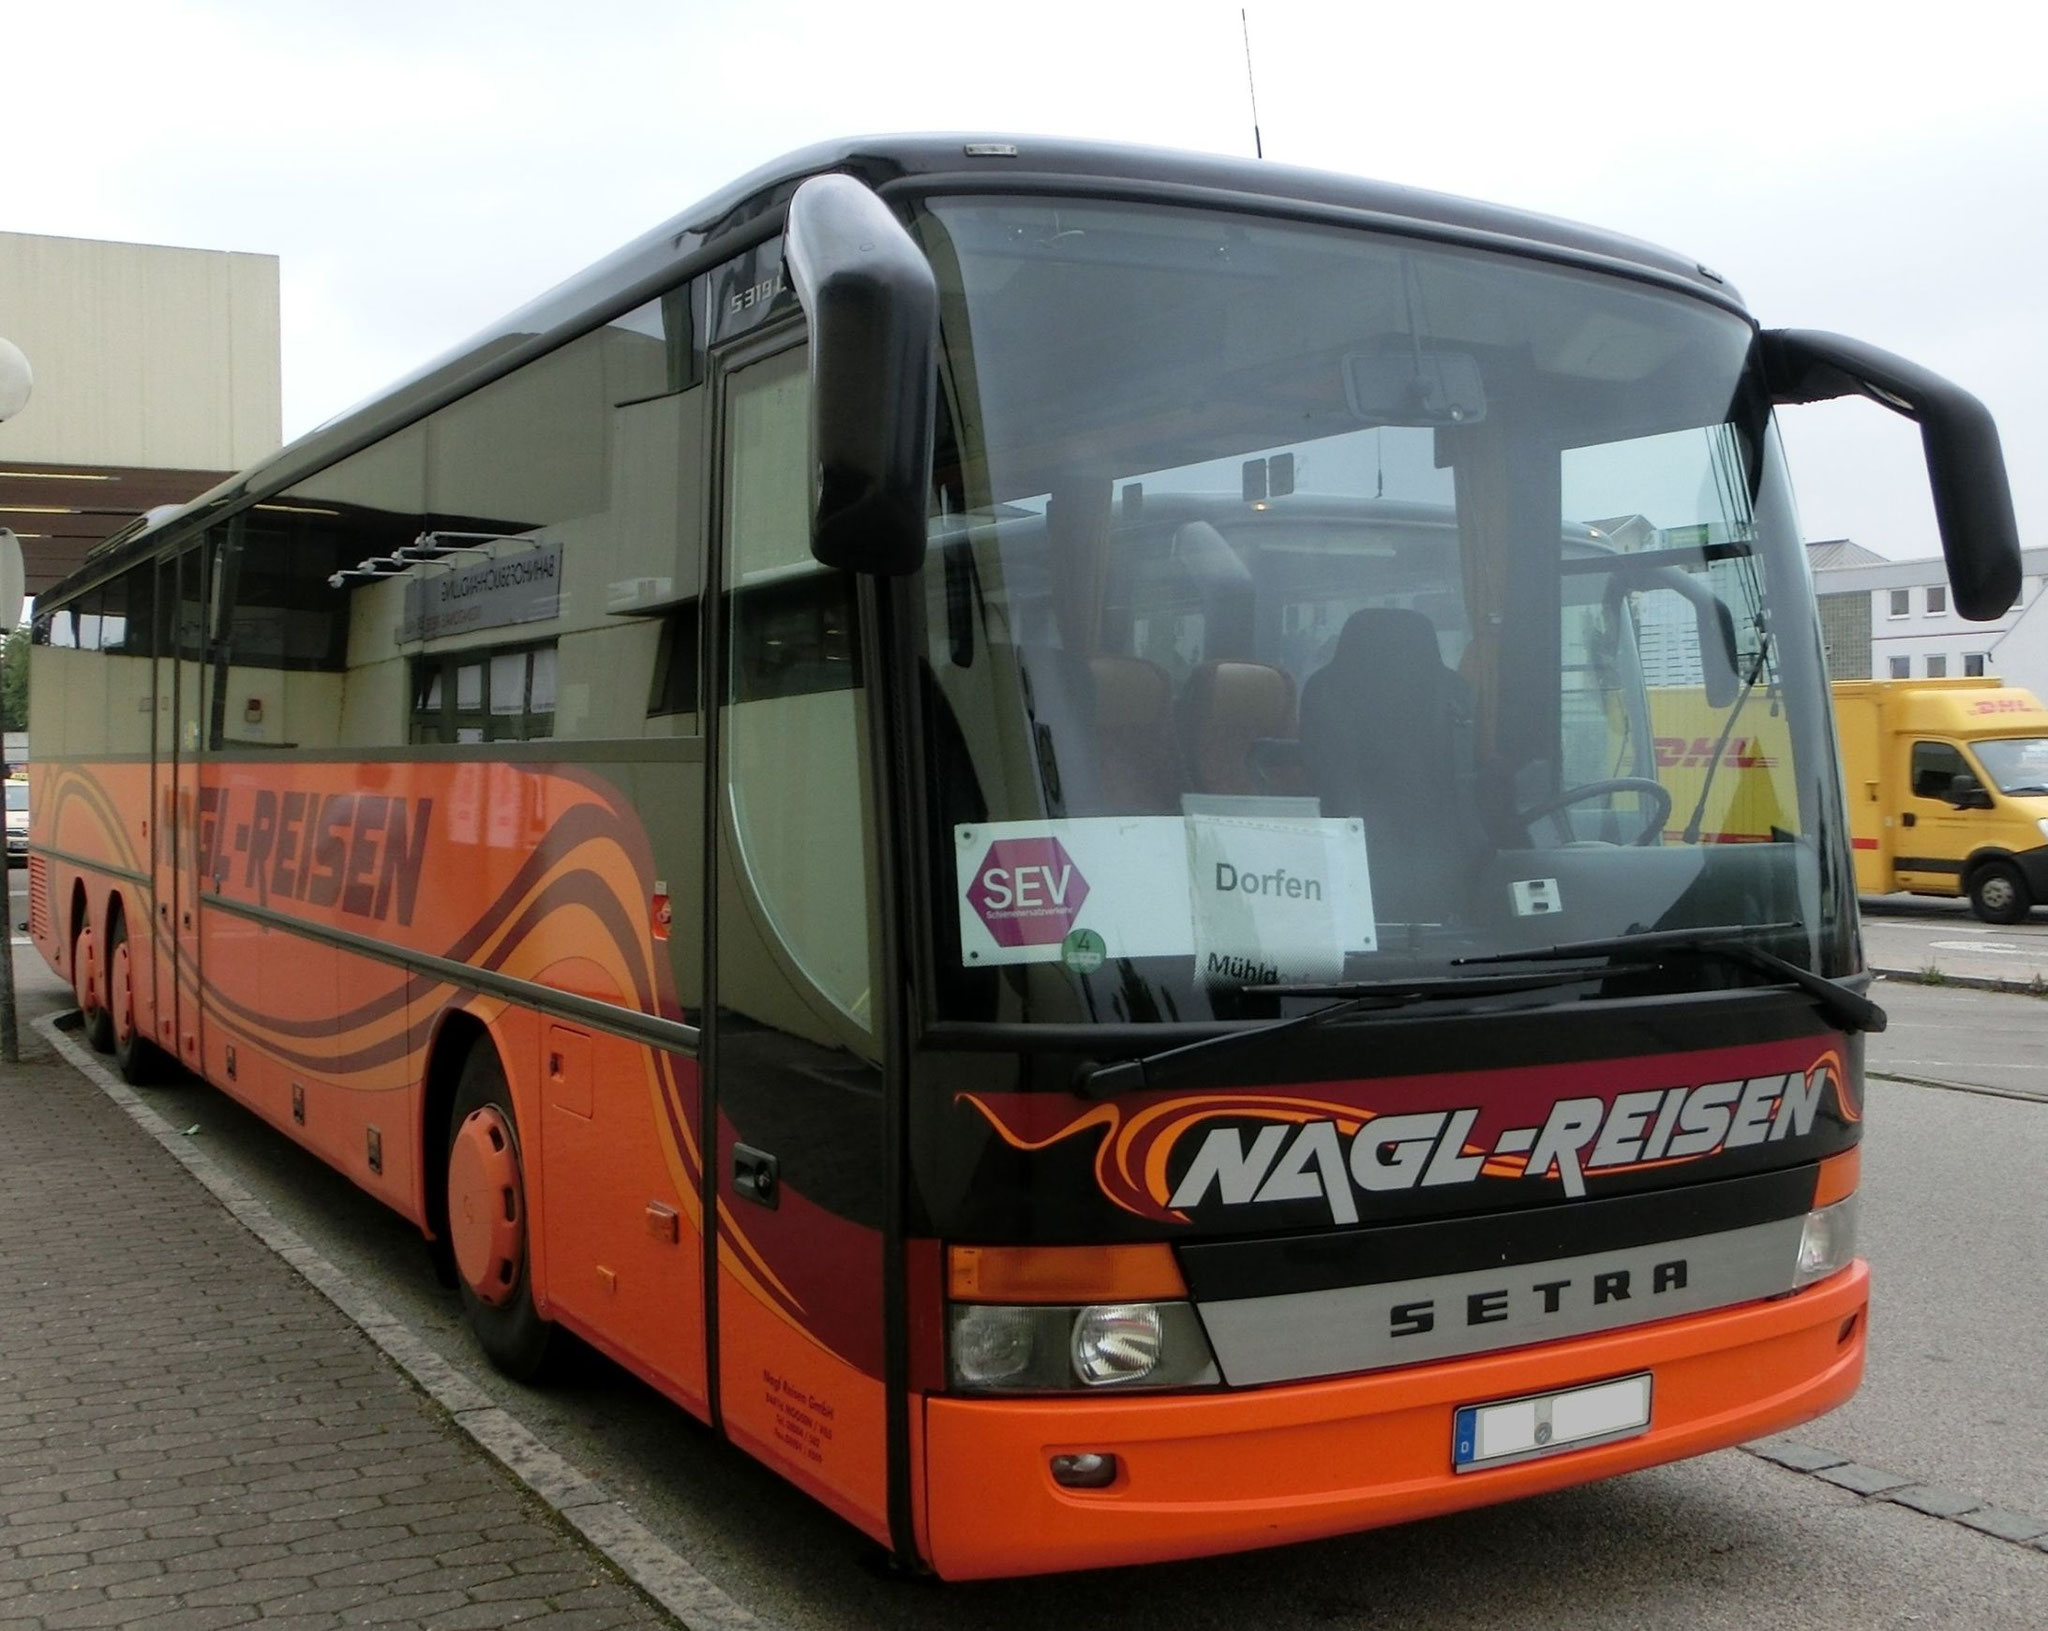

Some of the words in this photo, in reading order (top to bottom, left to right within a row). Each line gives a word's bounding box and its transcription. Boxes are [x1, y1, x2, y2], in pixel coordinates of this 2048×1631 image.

[1974, 699, 2033, 714] DHL
[1653, 736, 1755, 768] DHL
[156, 785, 434, 927] GL-REISEN
[982, 864, 1072, 910] SEV
[1214, 861, 1322, 901] Dorfen
[1077, 930, 1091, 951] 4
[1168, 1066, 1832, 1225] NAGL-REISEN
[1390, 1258, 1689, 1338] SETRA
[1460, 1440, 1470, 1454] D
